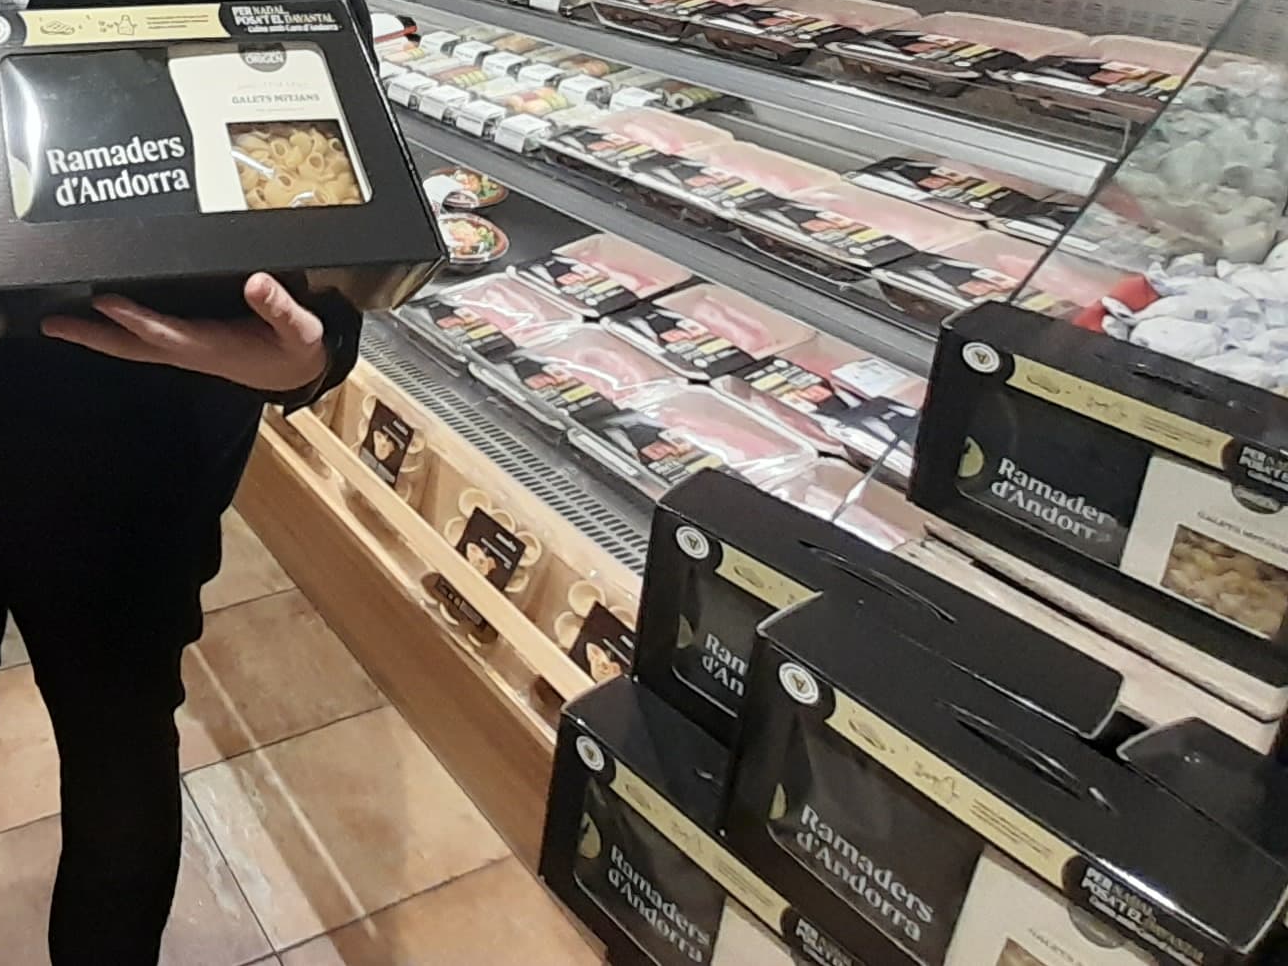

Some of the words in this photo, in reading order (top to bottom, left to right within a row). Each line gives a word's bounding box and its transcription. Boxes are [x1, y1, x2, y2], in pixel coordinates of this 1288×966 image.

[46, 134, 186, 177] Ramaders
[54, 164, 191, 208] d'Andorra
[610, 843, 711, 946] Ramaders
[796, 831, 922, 942] d'Andorra
[801, 803, 935, 924] Ramaders
[607, 867, 704, 964] d'Andorra
